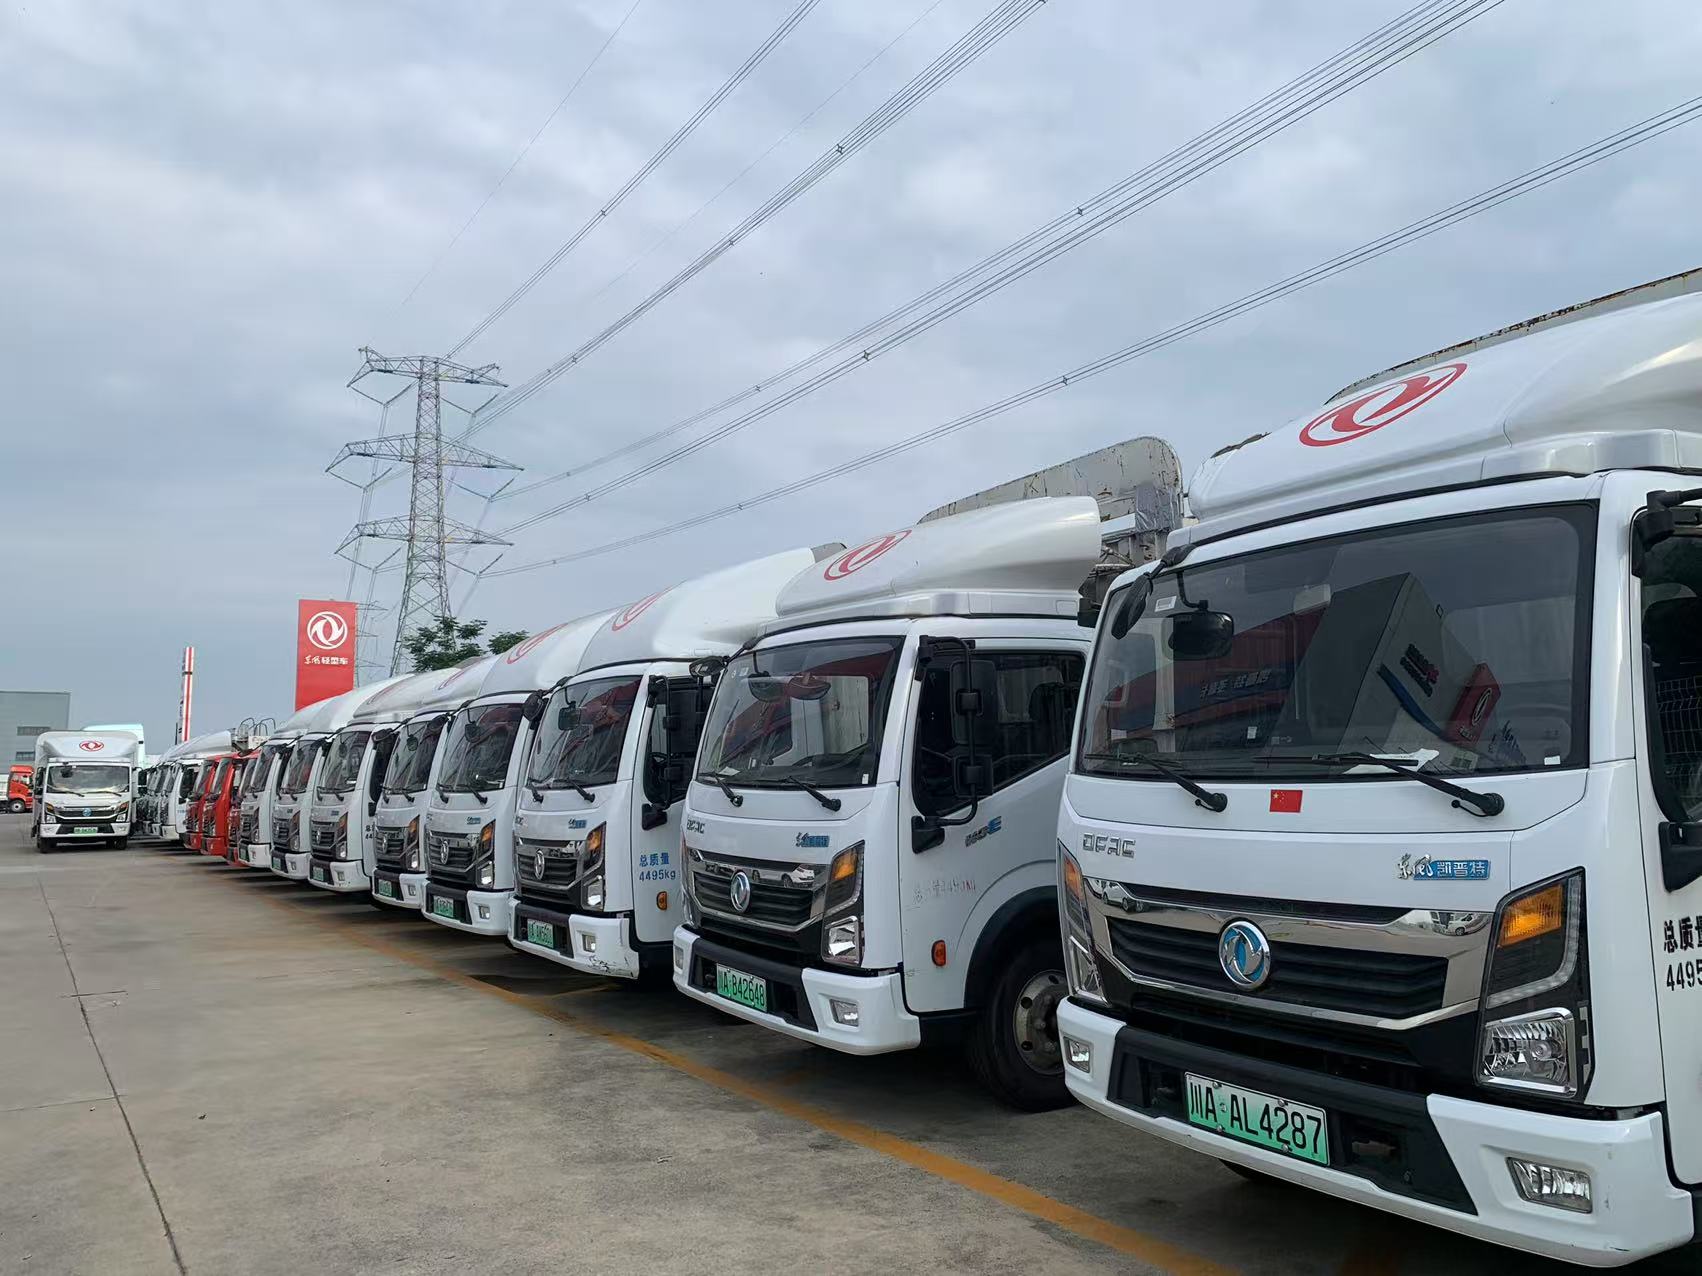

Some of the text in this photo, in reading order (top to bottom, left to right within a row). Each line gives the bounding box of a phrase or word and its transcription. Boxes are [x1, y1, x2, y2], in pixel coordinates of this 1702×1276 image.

[1082, 832, 1136, 858] DFAC
[639, 852, 670, 867] 总质量
[639, 869, 676, 881] 4495kg
